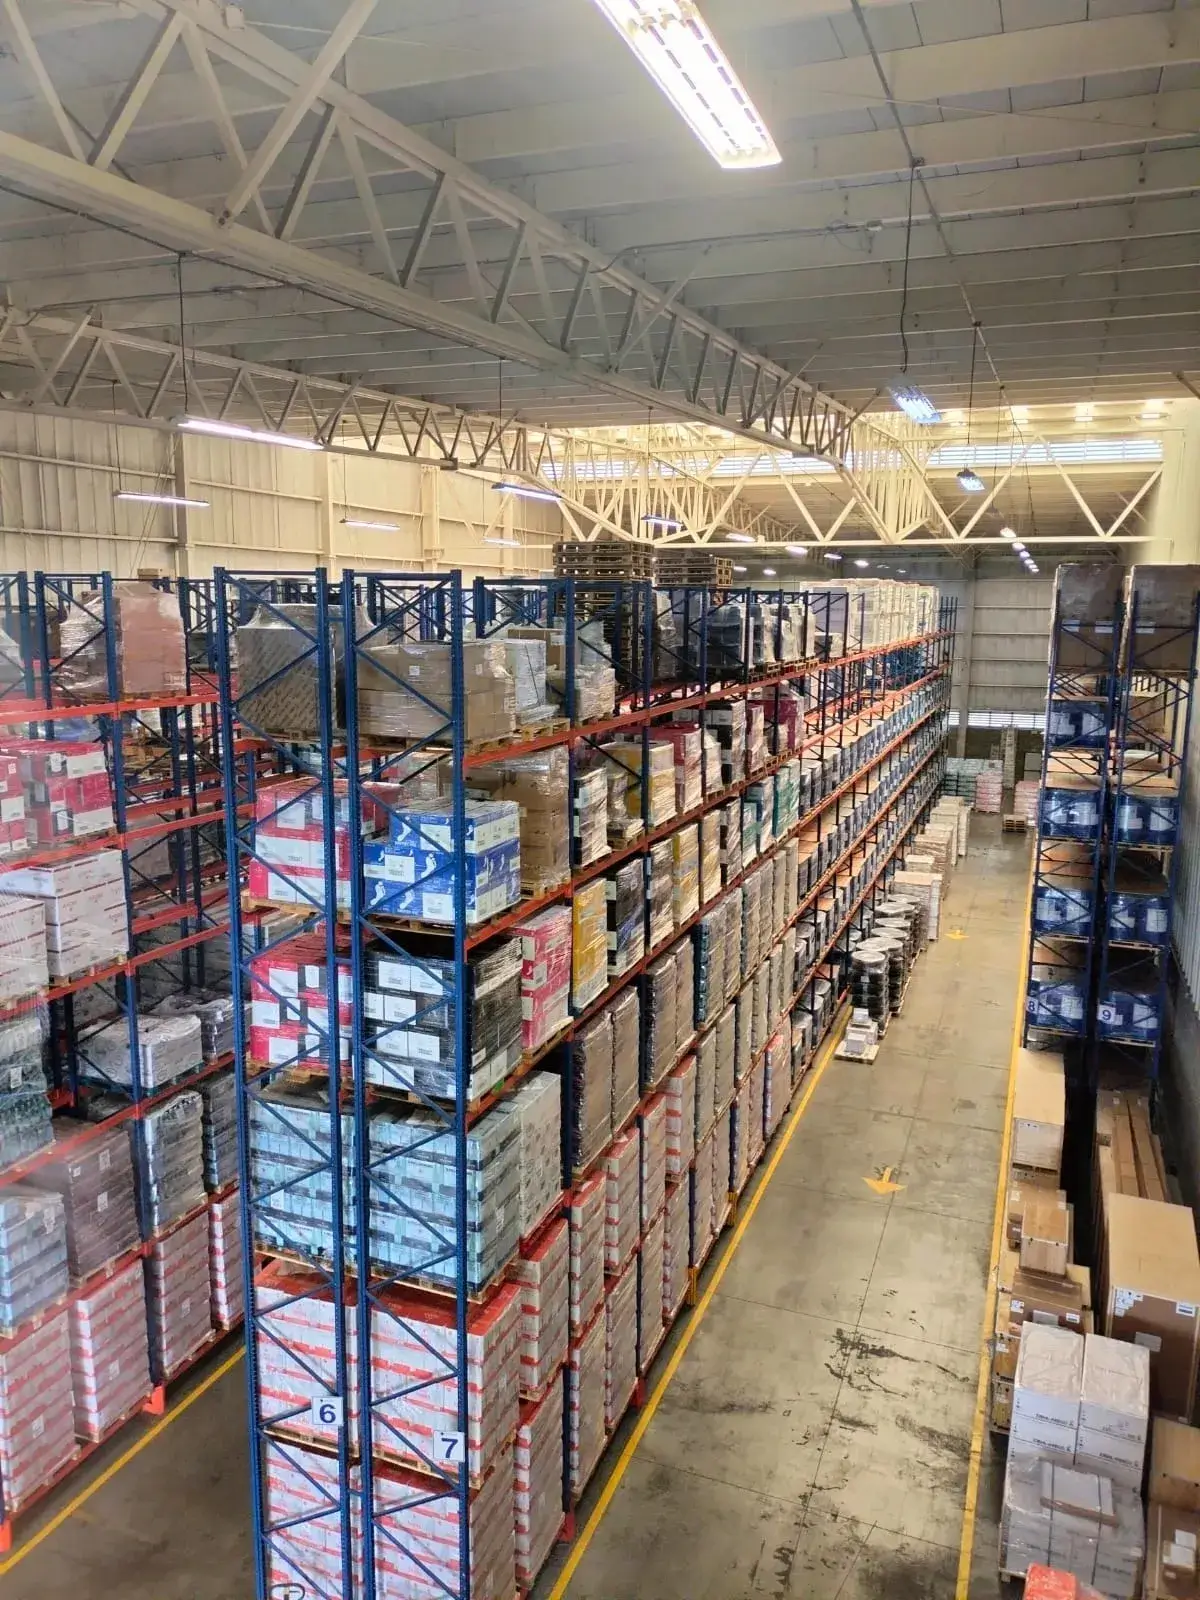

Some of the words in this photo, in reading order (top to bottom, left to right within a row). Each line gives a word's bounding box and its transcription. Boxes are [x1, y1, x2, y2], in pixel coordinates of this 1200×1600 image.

[1028, 1001, 1035, 1012] 8
[1102, 1009, 1112, 1021] 9
[319, 1404, 337, 1424] 6
[441, 1437, 458, 1459] 7
